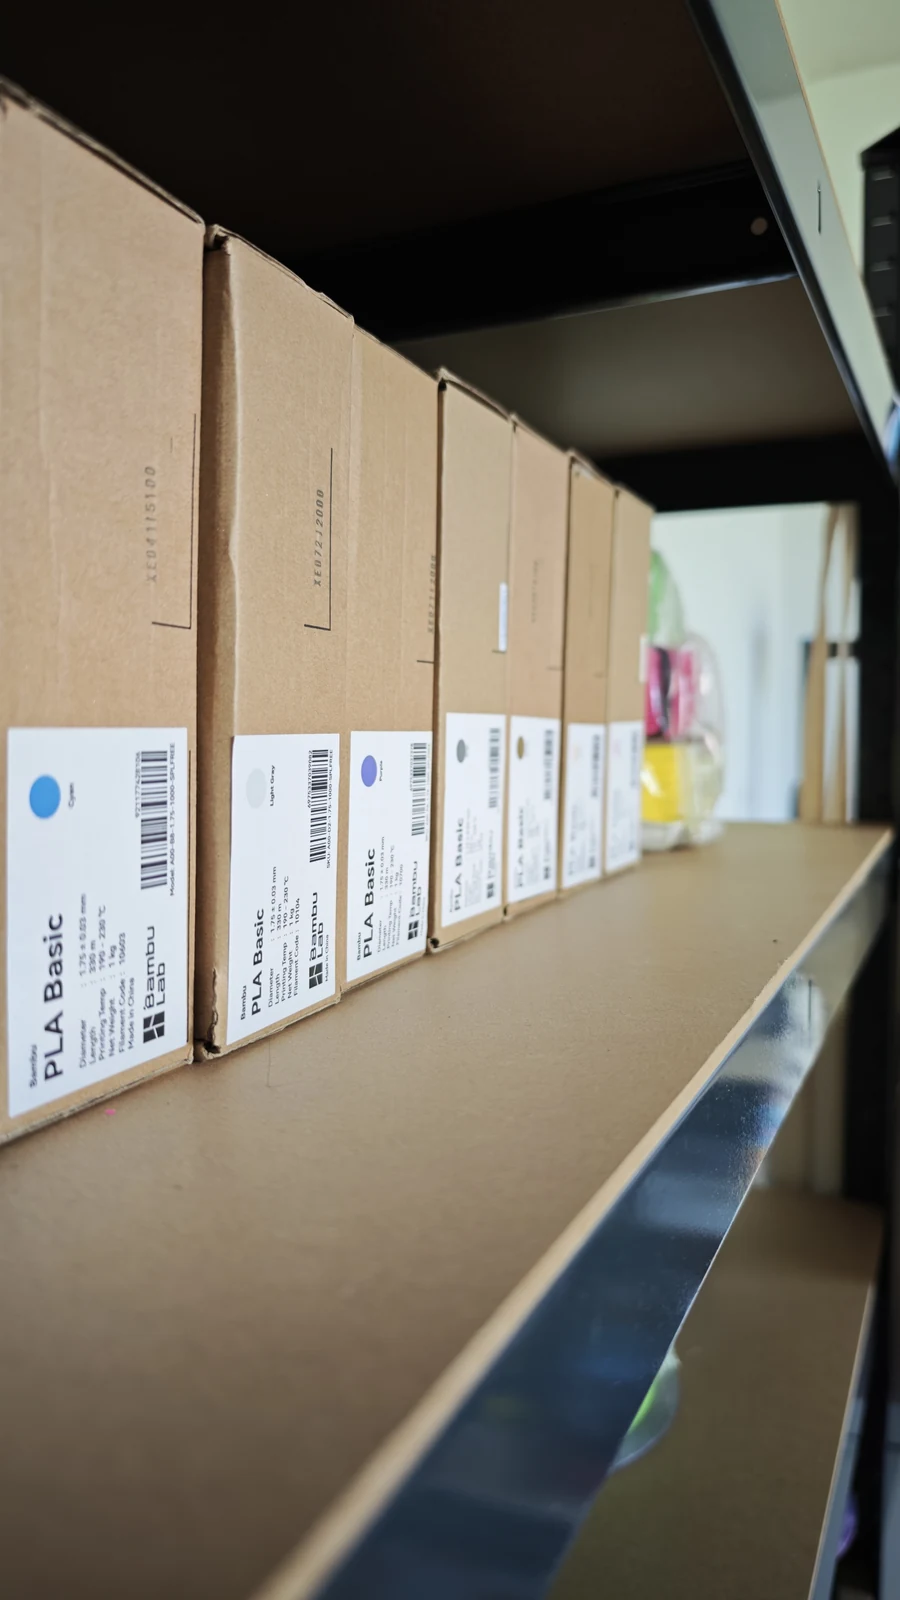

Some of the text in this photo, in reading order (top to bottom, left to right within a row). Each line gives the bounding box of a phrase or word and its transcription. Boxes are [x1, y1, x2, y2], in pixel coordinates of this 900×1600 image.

[272, 866, 277, 883] mm
[454, 818, 464, 911] PLA Basic
[80, 893, 87, 915] mm
[278, 903, 282, 912] m
[363, 848, 375, 958] PLA Basic
[409, 860, 418, 919] Bambu
[98, 918, 106, 940] 230
[289, 908, 295, 920] kg
[309, 892, 318, 961] Bambu
[90, 939, 96, 951] m
[98, 950, 106, 971] 190
[108, 945, 117, 960] kg
[251, 908, 264, 1016] PLA Basic
[143, 926, 155, 1010] Bambu
[156, 962, 166, 1006] Lab
[42, 913, 63, 1081] PLA Basic
[98, 988, 107, 1017] Temp
[118, 978, 126, 1007] Code
[108, 998, 117, 1035] Weight
[118, 1009, 126, 1053] Filament
[128, 1009, 134, 1019] in
[79, 1019, 87, 1068] Diameter
[89, 1026, 98, 1064] Length
[98, 1018, 107, 1061] Printing
[29, 1044, 38, 1088] Bambu
